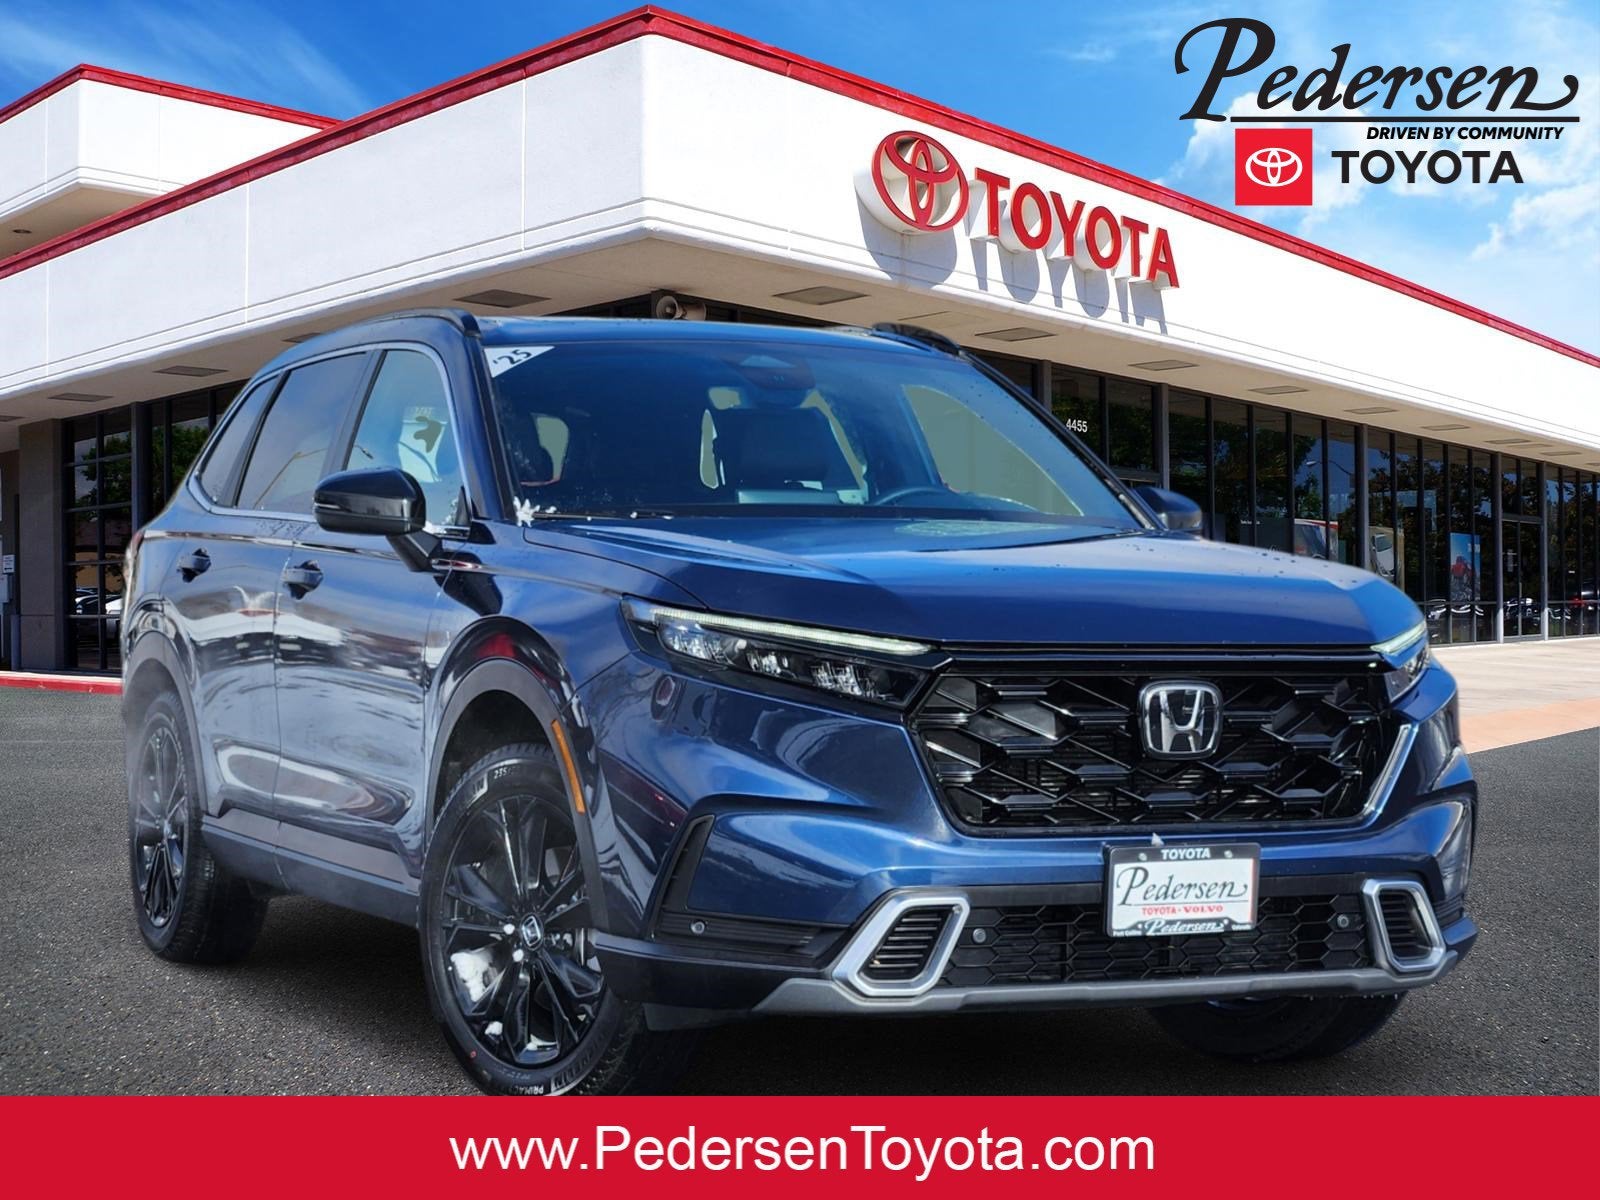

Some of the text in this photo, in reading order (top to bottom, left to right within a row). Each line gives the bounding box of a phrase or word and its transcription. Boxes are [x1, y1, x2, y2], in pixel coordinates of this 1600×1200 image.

[974, 167, 1180, 288] TOYOTA
[1065, 418, 1088, 433] 4455
[1161, 847, 1211, 861] TOYOTA
[1116, 866, 1248, 907] Pedersen
[1141, 905, 1223, 916] TOYOTA VOLVO
[1143, 918, 1225, 936] Pedersen
